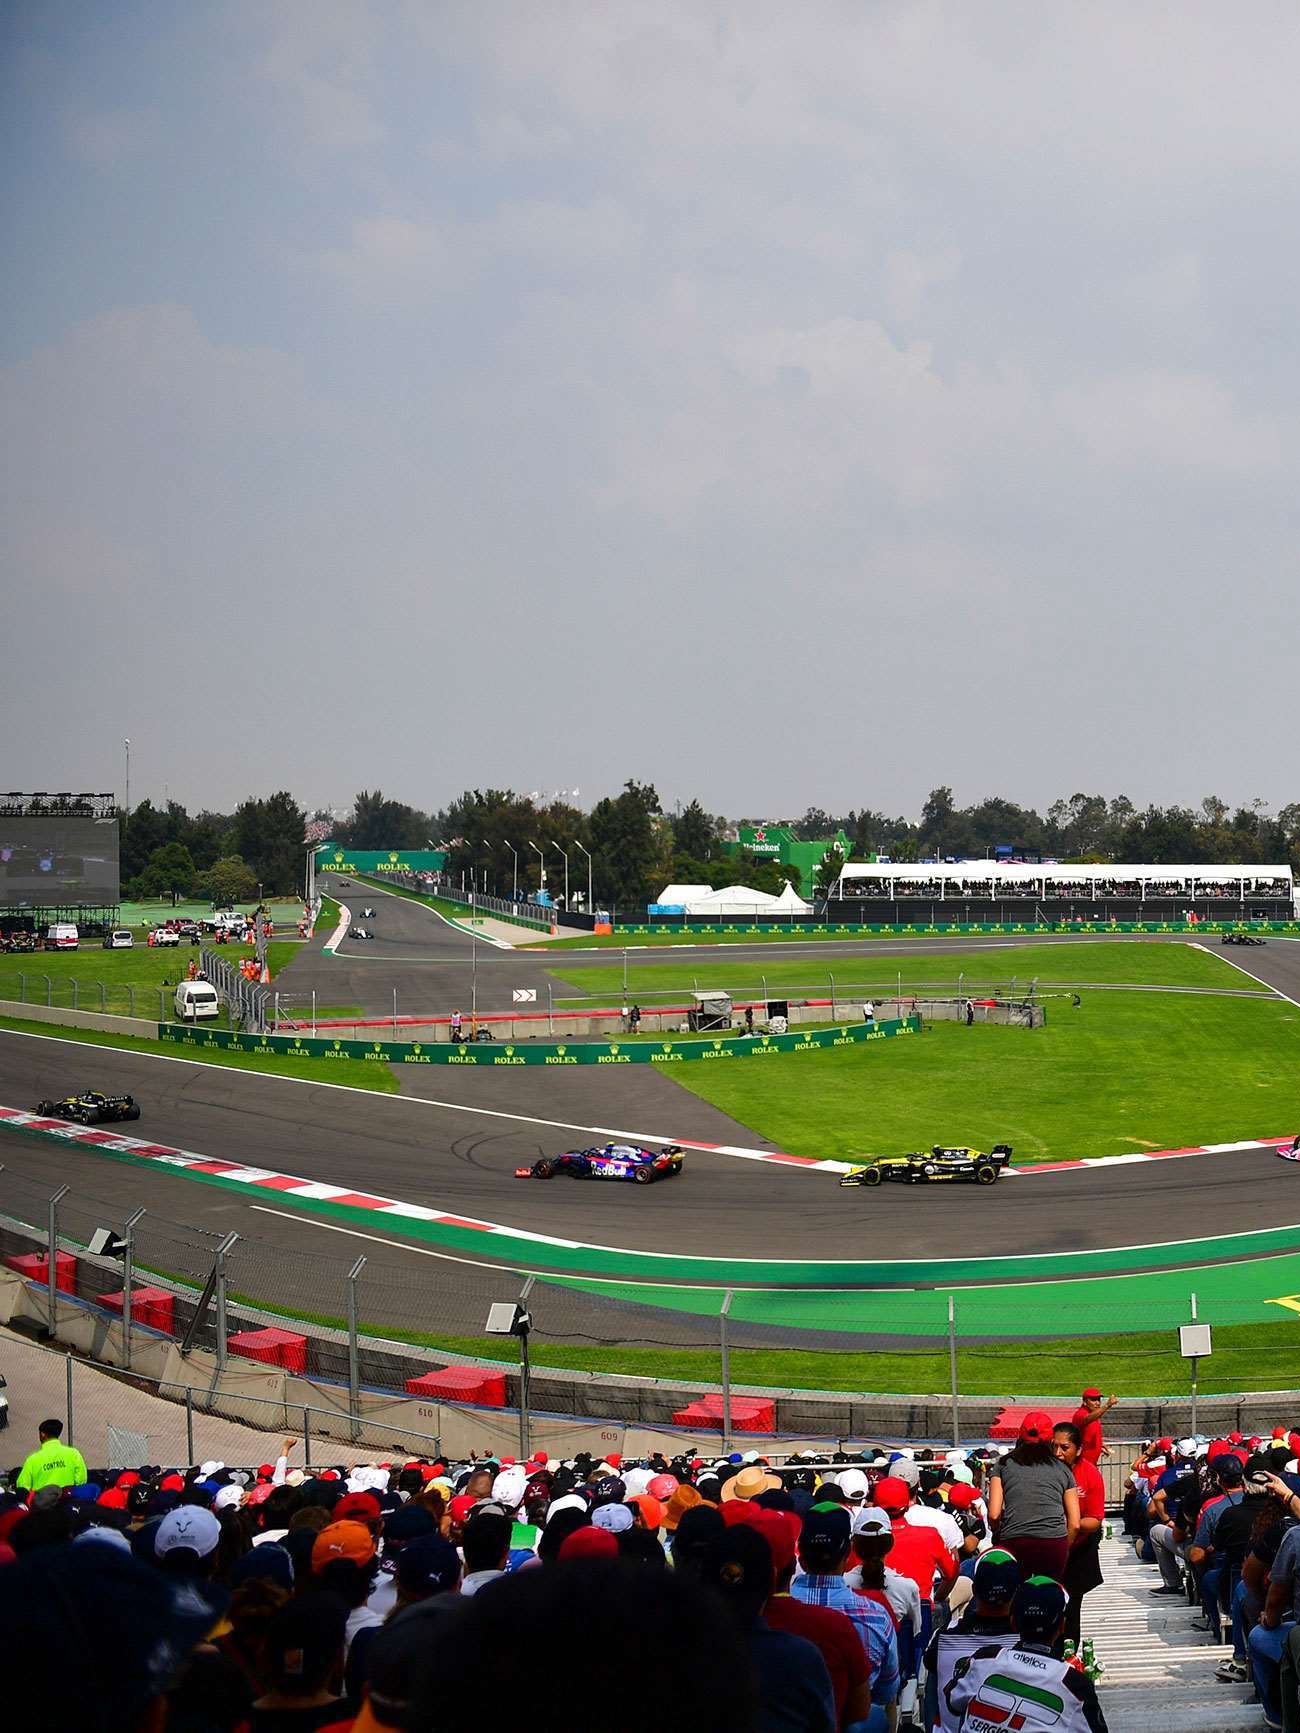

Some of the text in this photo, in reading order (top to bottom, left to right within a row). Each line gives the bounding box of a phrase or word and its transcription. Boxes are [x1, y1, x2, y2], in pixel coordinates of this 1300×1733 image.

[322, 863, 356, 871] ROLEX
[377, 863, 410, 871] ROLEX
[896, 1027, 914, 1035] ROLEX
[866, 1031, 886, 1040] ROLEX
[834, 1036, 854, 1046] ROLEX
[254, 1046, 275, 1054] ROLEX
[795, 1041, 821, 1051] ROLEX
[287, 1048, 310, 1056] ROLEX
[325, 1050, 350, 1058] ROLEX
[702, 1050, 734, 1058] ROLEX
[752, 1046, 779, 1055] ROLEX
[365, 1053, 390, 1061] ROLEX
[404, 1055, 430, 1063] ROLEX
[448, 1056, 476, 1064] ROLEX
[546, 1056, 578, 1064] ROLEX
[598, 1055, 631, 1063] ROLEX
[418, 1408, 433, 1418] 610
[601, 1432, 618, 1441] 609
[43, 1460, 66, 1471] CONTROL
[1012, 1652, 1047, 1670] atletica
